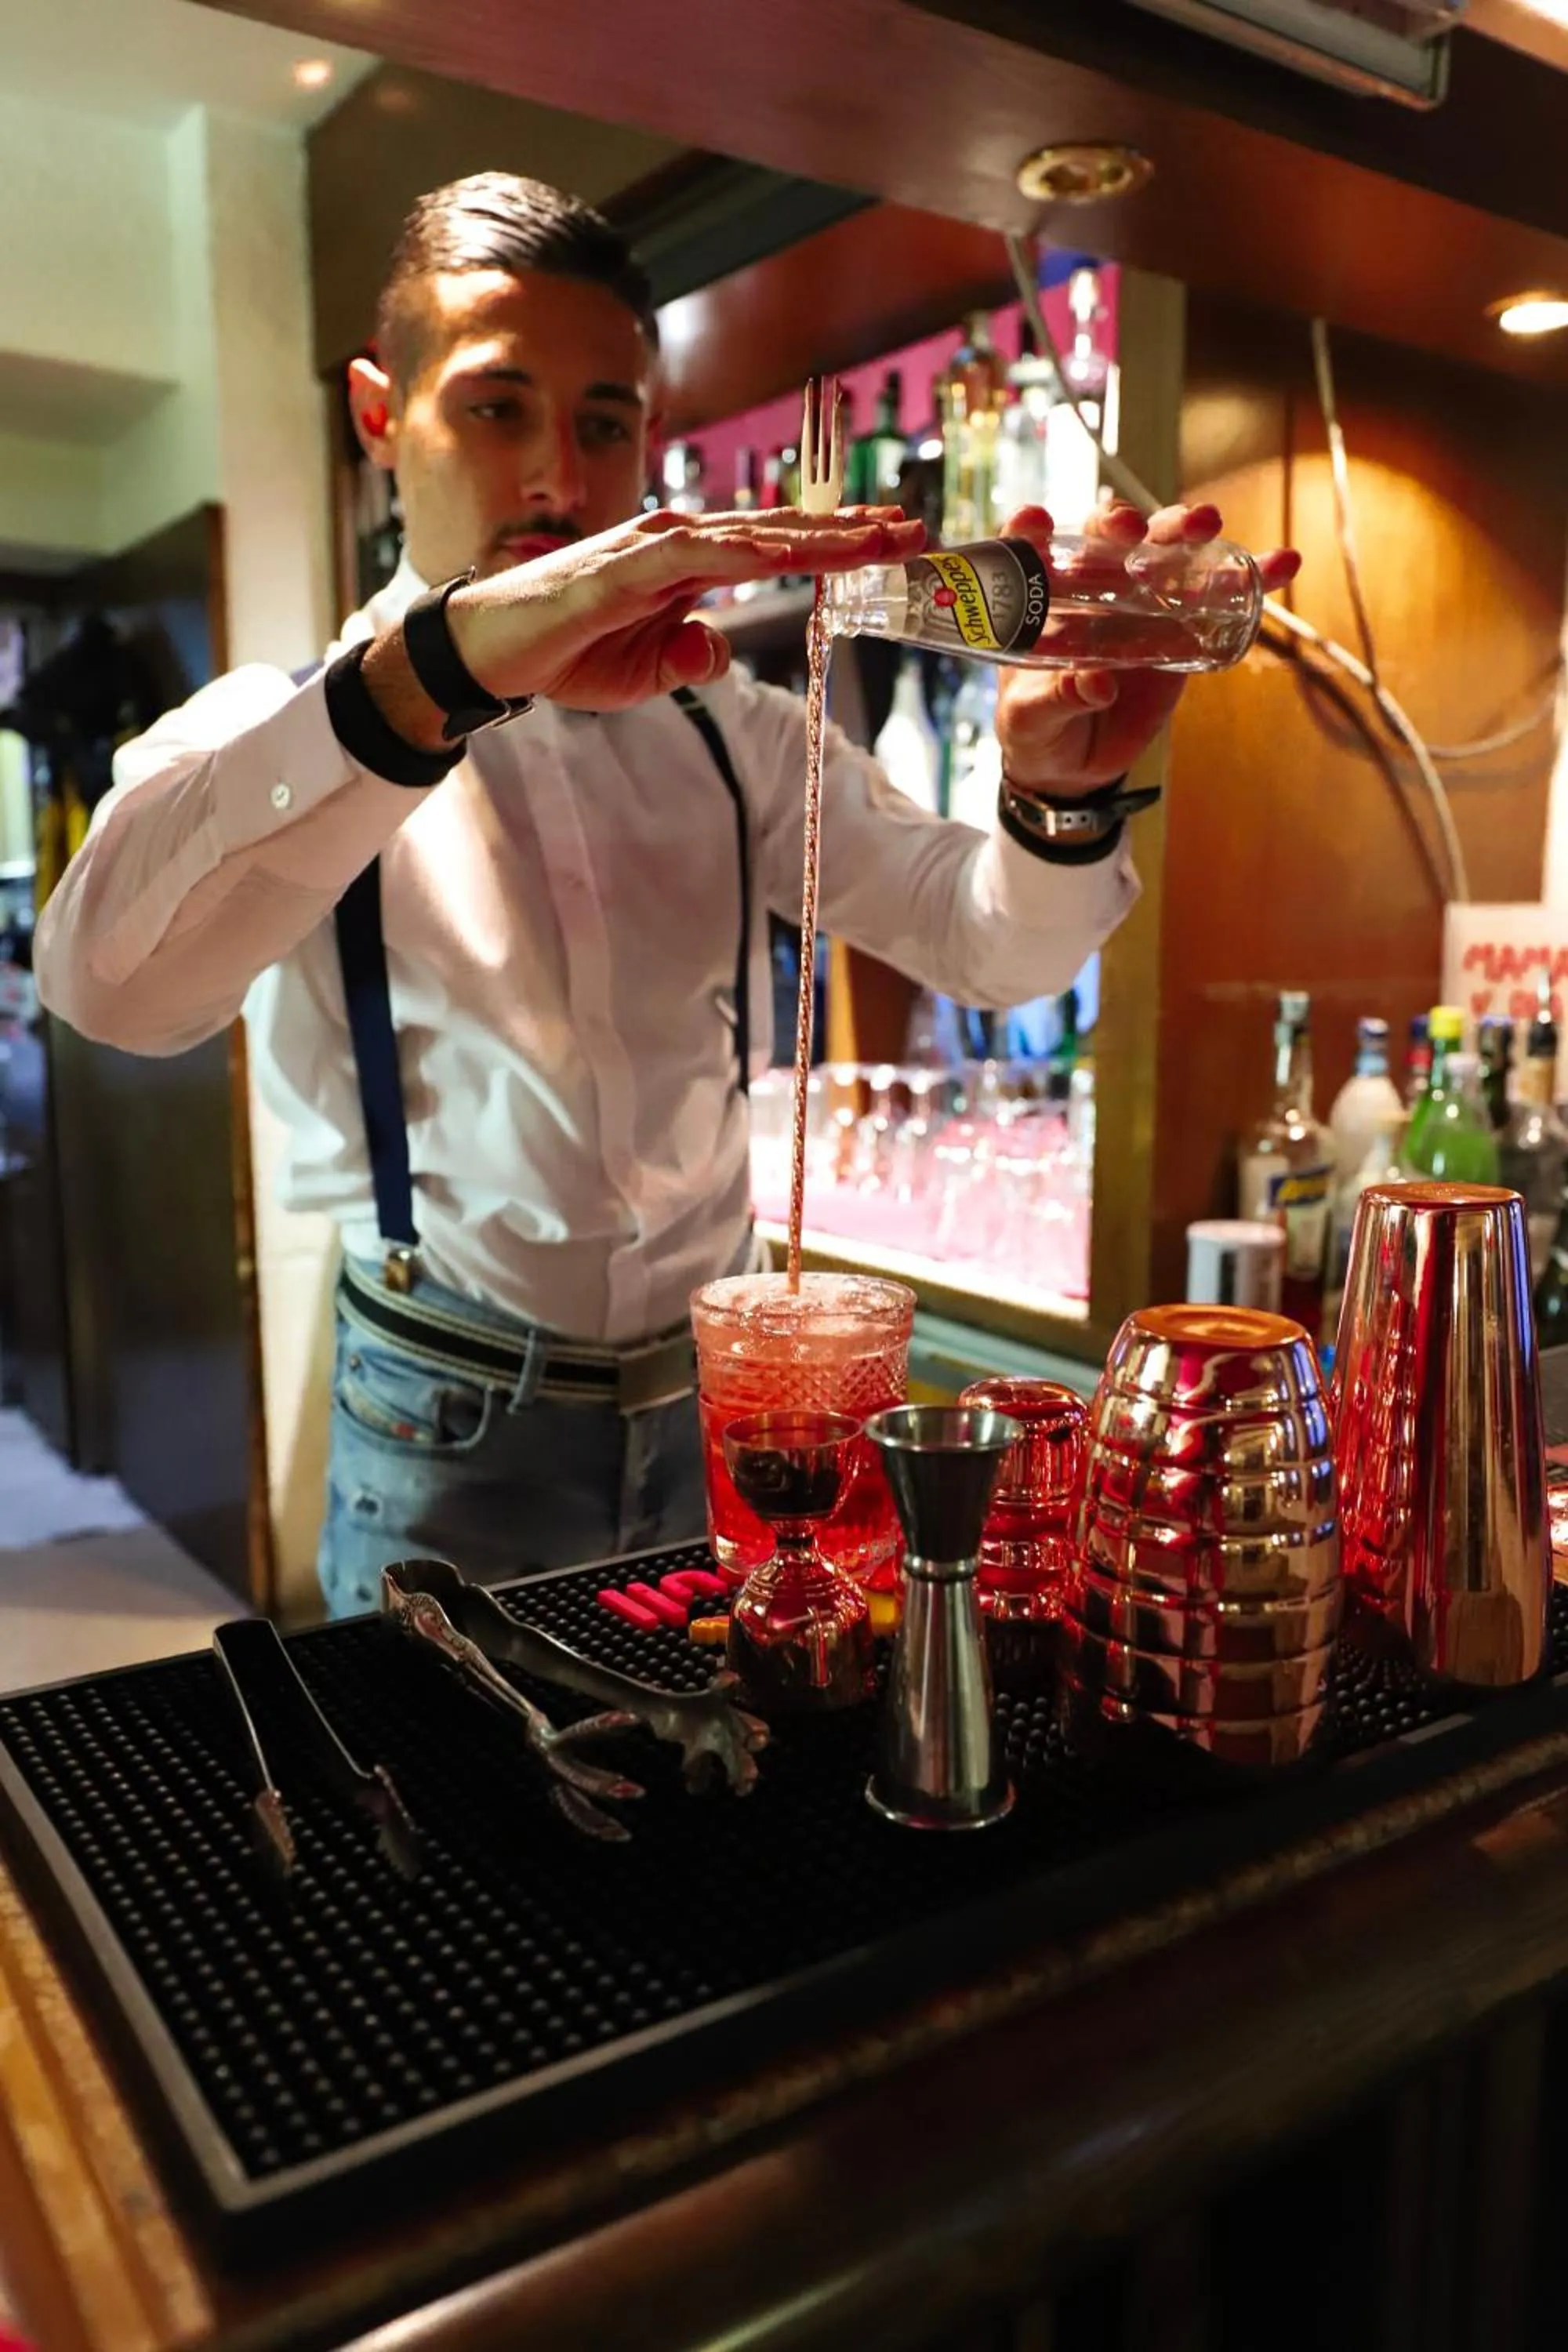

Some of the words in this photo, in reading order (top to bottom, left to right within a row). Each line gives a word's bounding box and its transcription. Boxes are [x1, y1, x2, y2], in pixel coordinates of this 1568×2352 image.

[938, 556, 991, 645] Schweppes
[993, 572, 1012, 619] 1783
[1025, 573, 1044, 626] SODA
